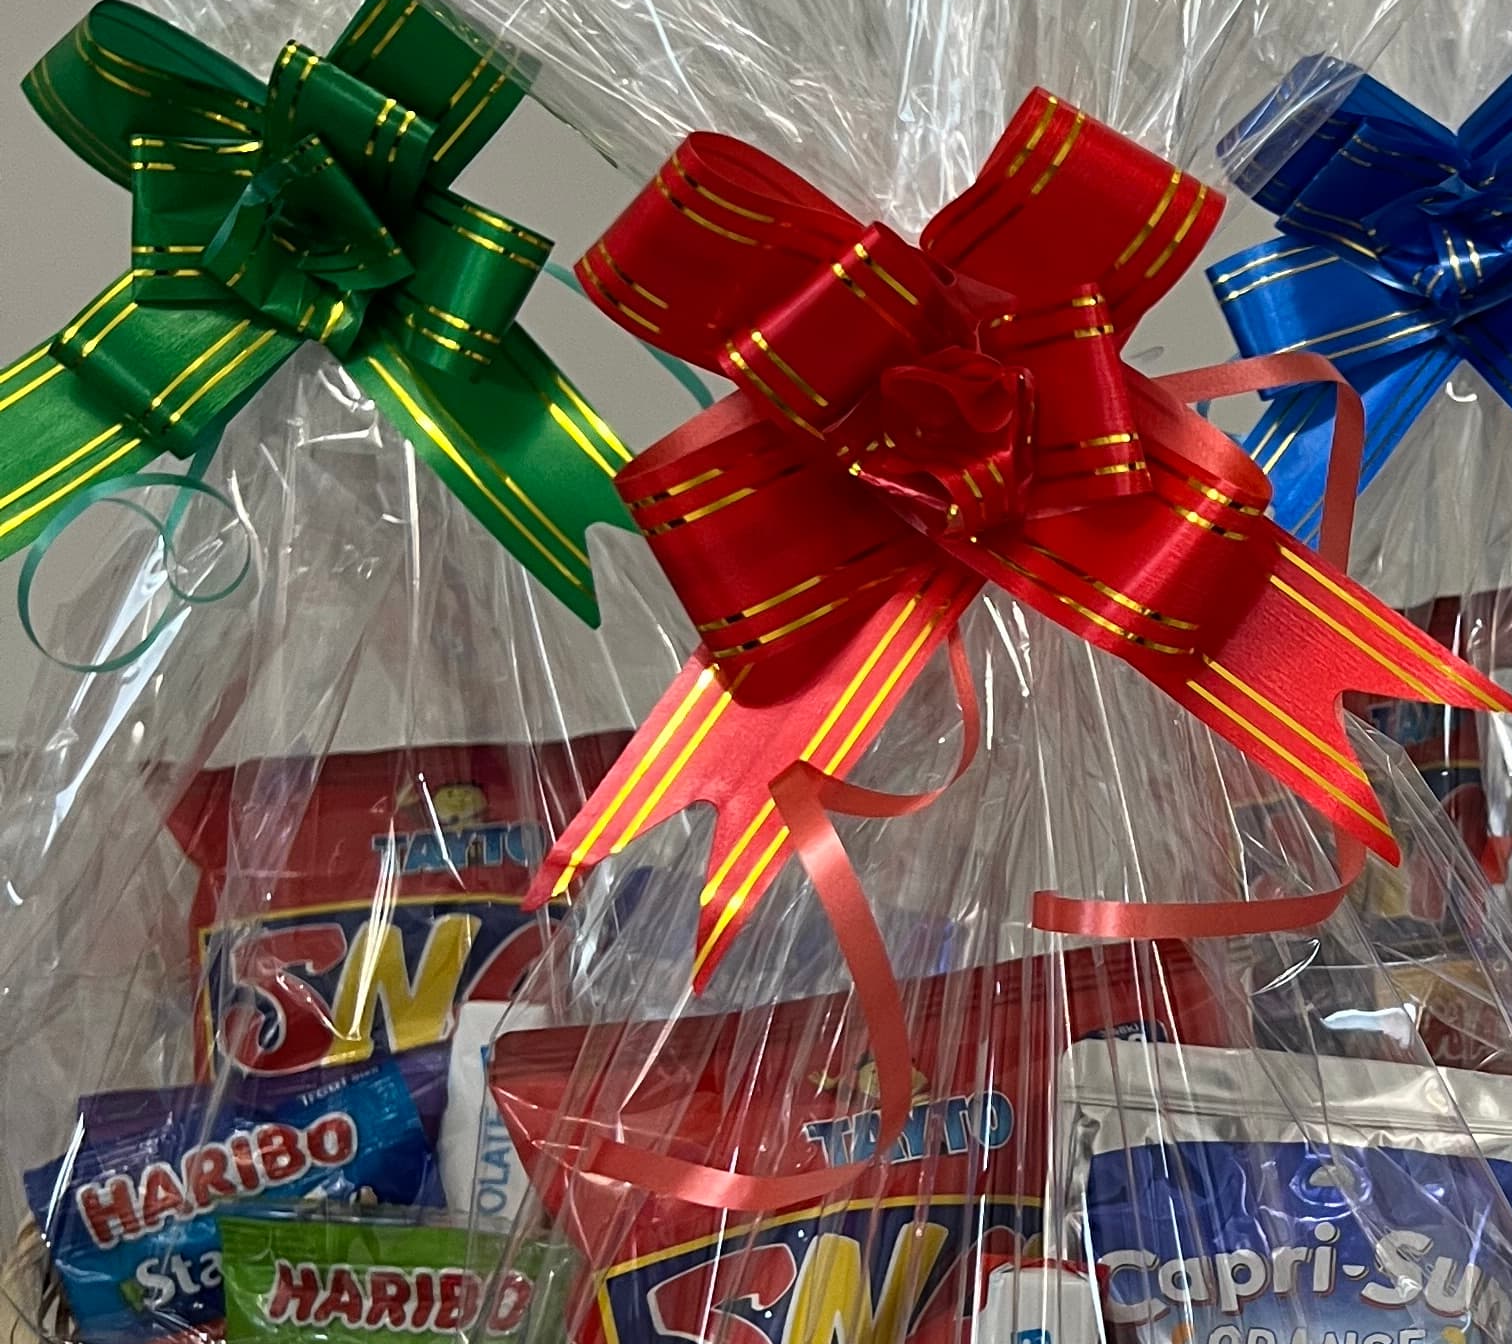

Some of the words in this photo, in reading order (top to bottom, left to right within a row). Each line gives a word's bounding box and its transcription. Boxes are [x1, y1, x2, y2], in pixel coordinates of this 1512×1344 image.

[801, 1089, 1015, 1171] TAYTO
[76, 1111, 358, 1250] HARIBO
[267, 1258, 535, 1337] HARIBO
